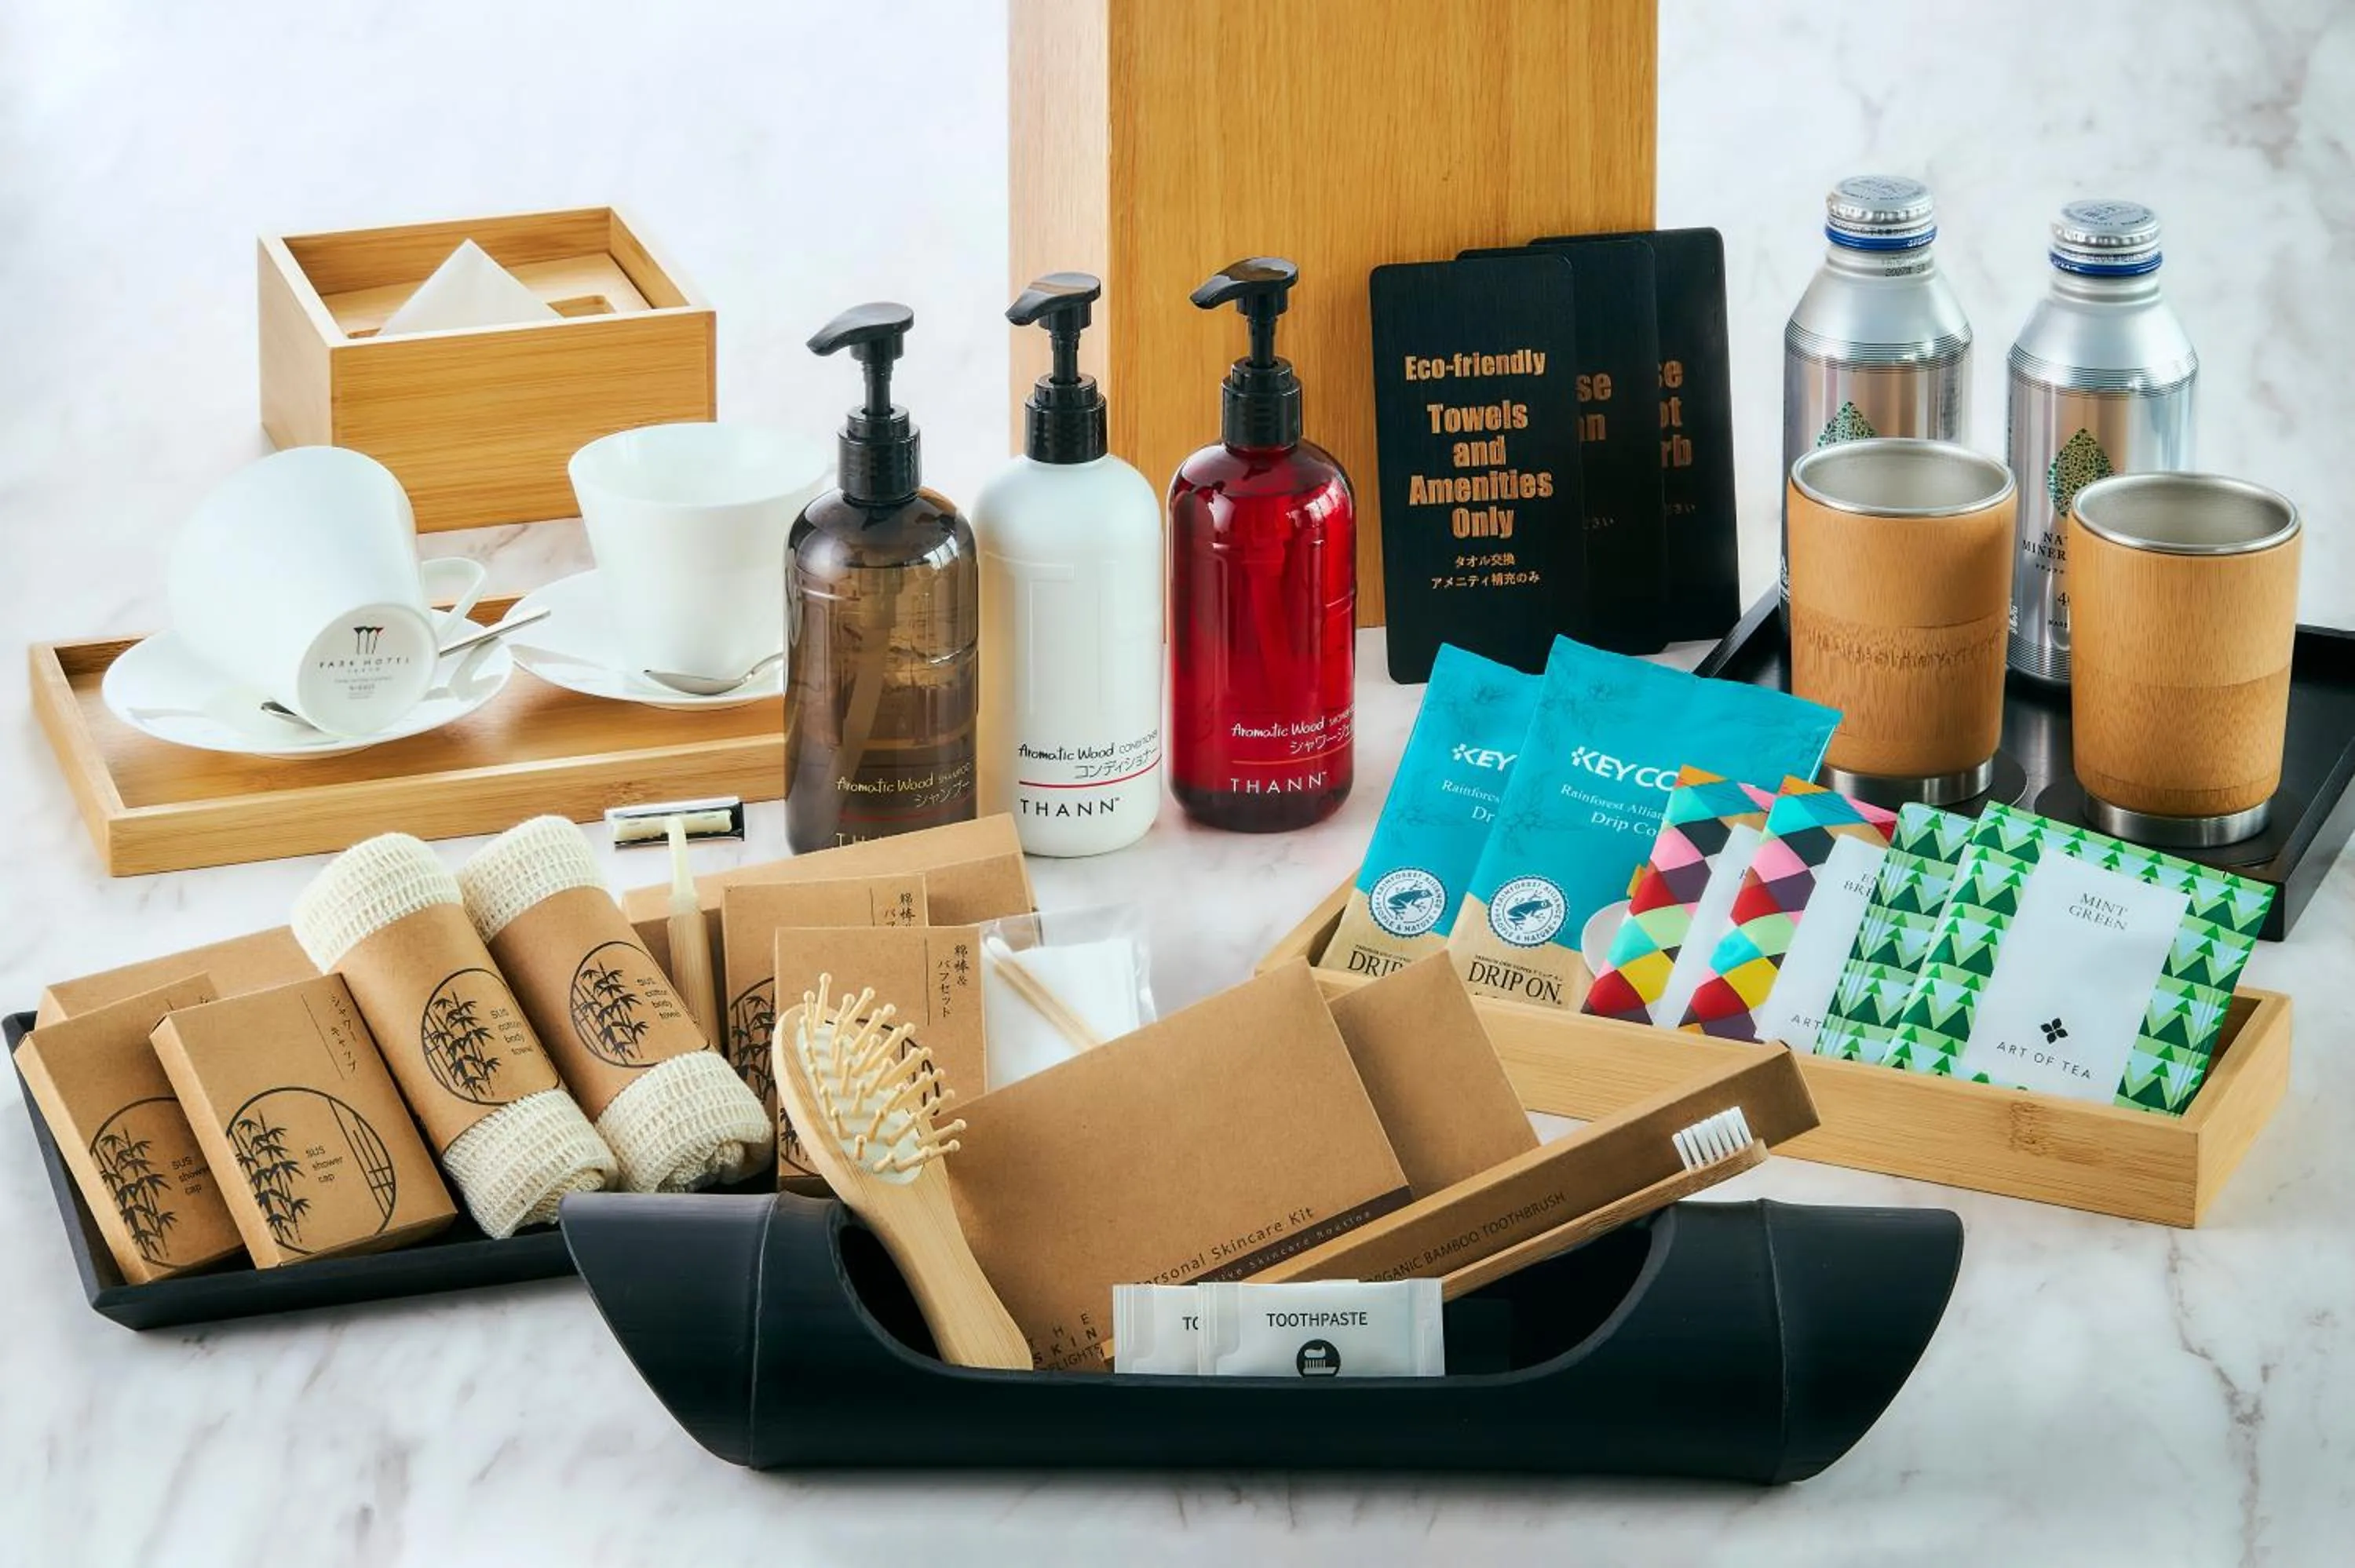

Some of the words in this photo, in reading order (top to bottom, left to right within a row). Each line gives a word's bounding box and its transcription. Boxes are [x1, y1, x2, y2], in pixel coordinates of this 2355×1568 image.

[1405, 349, 1546, 381] Eco-friendly
[1426, 399, 1528, 433] Towels
[1453, 435, 1506, 468] and
[1409, 469, 1554, 505] Amenities
[1452, 505, 1514, 538] Only
[2043, 532, 2068, 545] NA
[1455, 552, 1516, 568] タオル交換
[1430, 571, 1541, 589] アメニティ補充のみ
[1231, 723, 1288, 738] Aromatic
[1291, 715, 1325, 735] Wood
[1019, 743, 1075, 761] Aromatic
[1078, 742, 1115, 760] Wood
[1452, 743, 1518, 771] KEY
[1571, 746, 1638, 782] KEY
[836, 776, 895, 794] Aromatic
[897, 771, 933, 792] Wood
[1231, 772, 1322, 795] THANN
[1020, 797, 1115, 817] THANN
[1561, 783, 1624, 811] Rainforest
[1590, 811, 1628, 833] Drip
[2080, 892, 2128, 917] MINT
[2068, 904, 2127, 931] GREEN
[1468, 960, 1524, 991] DRIP
[1791, 1014, 1822, 1030] ART
[503, 1032, 526, 1045] body
[1996, 1041, 2027, 1056] ART
[2034, 1052, 2055, 1066] OF
[2062, 1060, 2091, 1079] TEA
[172, 1156, 193, 1170] SUS
[184, 1184, 203, 1196] cap
[1425, 1231, 1481, 1266] BAMBOO
[1483, 1191, 1567, 1236] TOOTHBRUSH
[1136, 1253, 1207, 1284] rsonal
[1211, 1221, 1284, 1261] Skincare
[1288, 1205, 1315, 1227] Kit
[1248, 1238, 1310, 1268] Skincare
[1265, 1312, 1368, 1329] TOOTHPASTE
